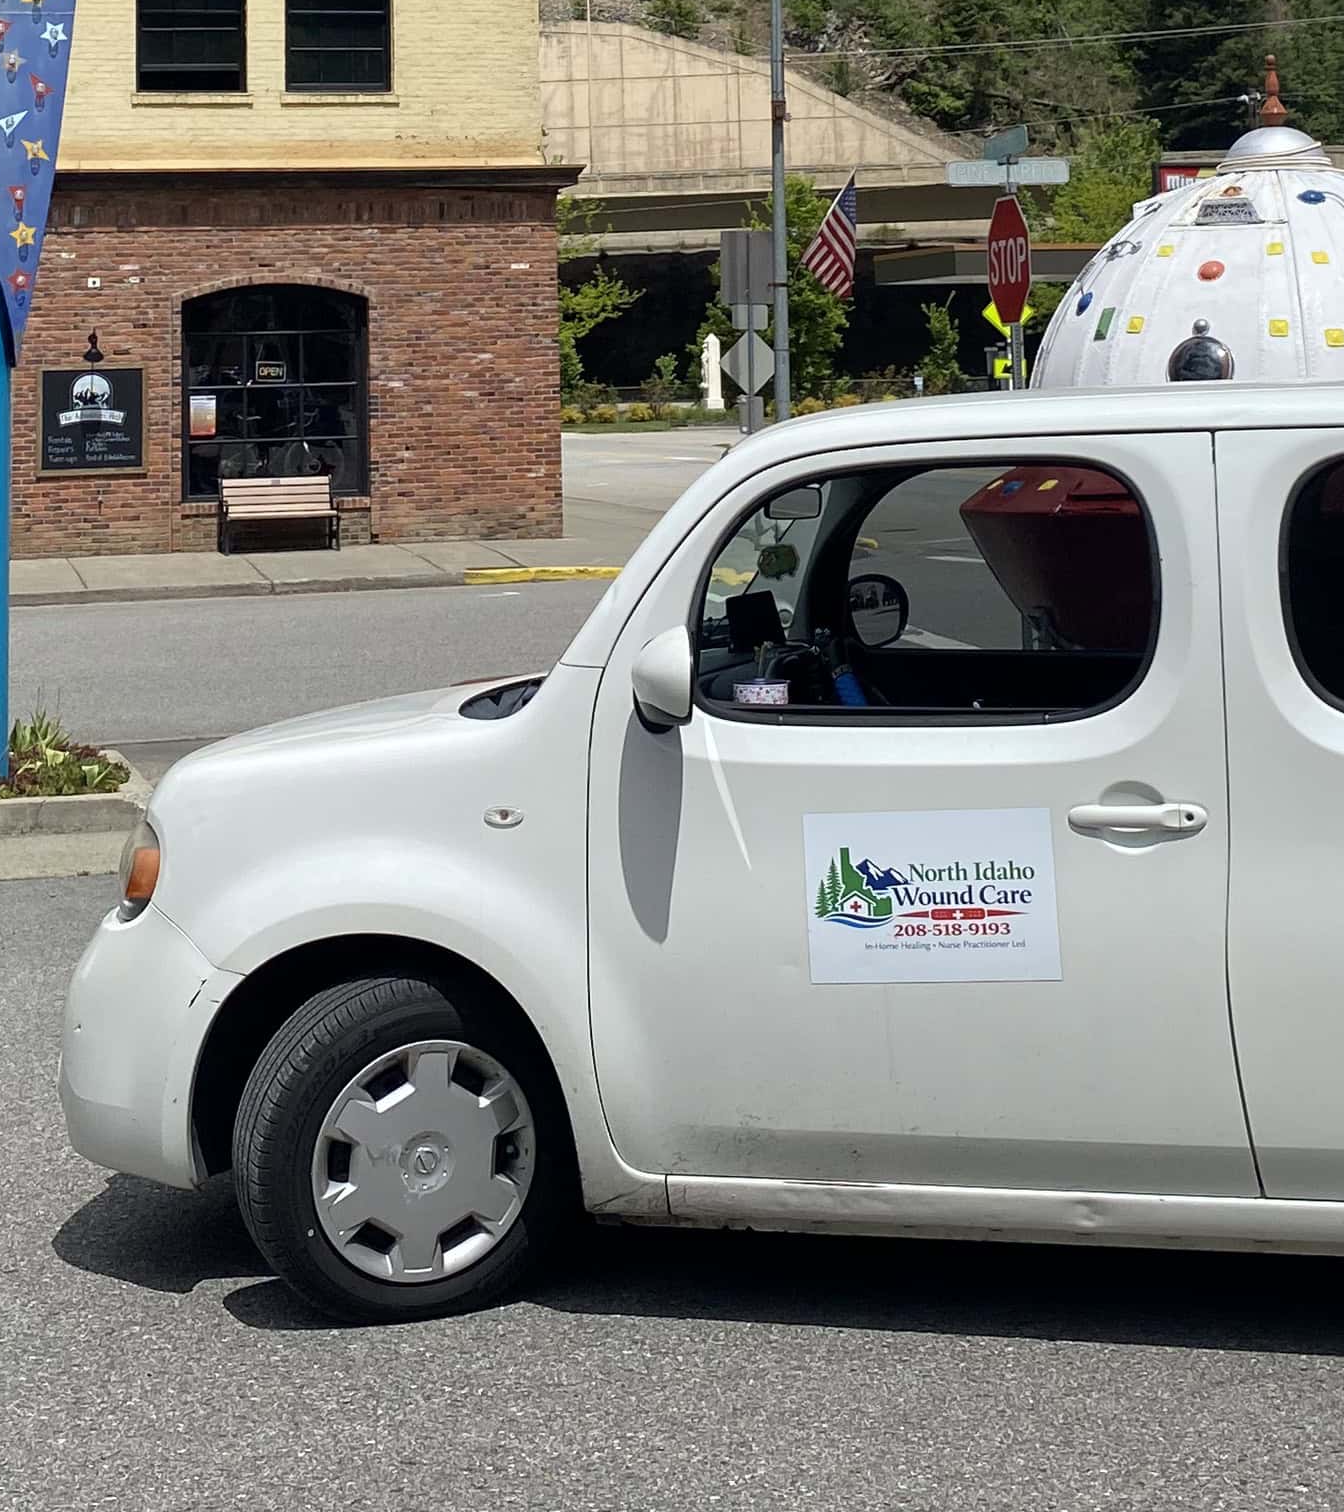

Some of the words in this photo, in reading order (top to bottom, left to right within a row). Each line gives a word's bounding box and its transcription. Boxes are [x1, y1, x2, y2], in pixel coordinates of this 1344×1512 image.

[991, 237, 1026, 285] STOP
[259, 367, 283, 376] OPEN
[908, 861, 968, 882] North
[974, 860, 1035, 880] Idaho
[891, 884, 974, 906] Wound
[979, 884, 1032, 905] Care
[894, 923, 1010, 936] 208-518-9193
[864, 942, 899, 950] In-Home
[901, 941, 931, 951] Healing
[938, 941, 961, 949] Nurse
[964, 939, 1009, 948] Practitioner
